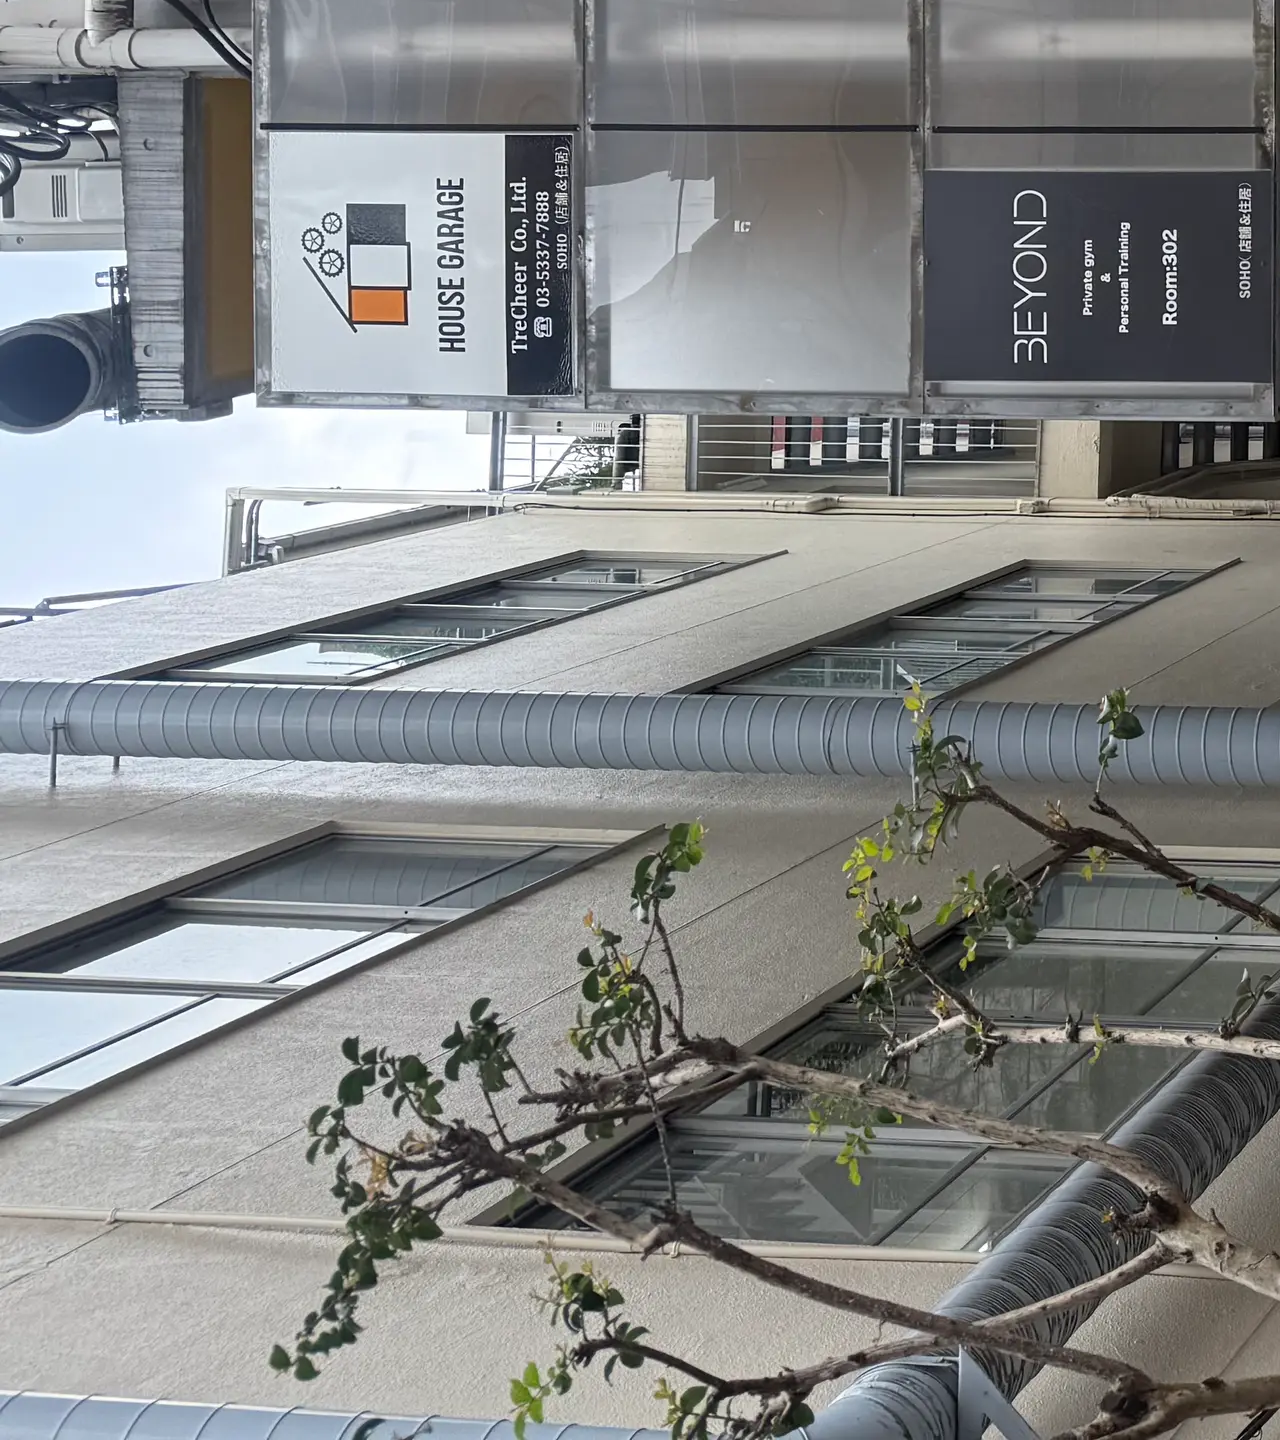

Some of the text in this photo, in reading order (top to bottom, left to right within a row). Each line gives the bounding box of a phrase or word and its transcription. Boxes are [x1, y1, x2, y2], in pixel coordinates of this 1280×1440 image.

[436, 178, 466, 353] HOUSE GARAGE
[509, 176, 530, 354] TreCheer Co., Ltd.
[535, 191, 550, 308] 03-5337-7888
[556, 233, 568, 270] SOHO
[1012, 189, 1048, 364] BEYOND
[1082, 239, 1095, 316] Private gym
[1100, 272, 1111, 283] &
[1118, 222, 1131, 333] Personal Training
[1162, 229, 1178, 325] Room:302
